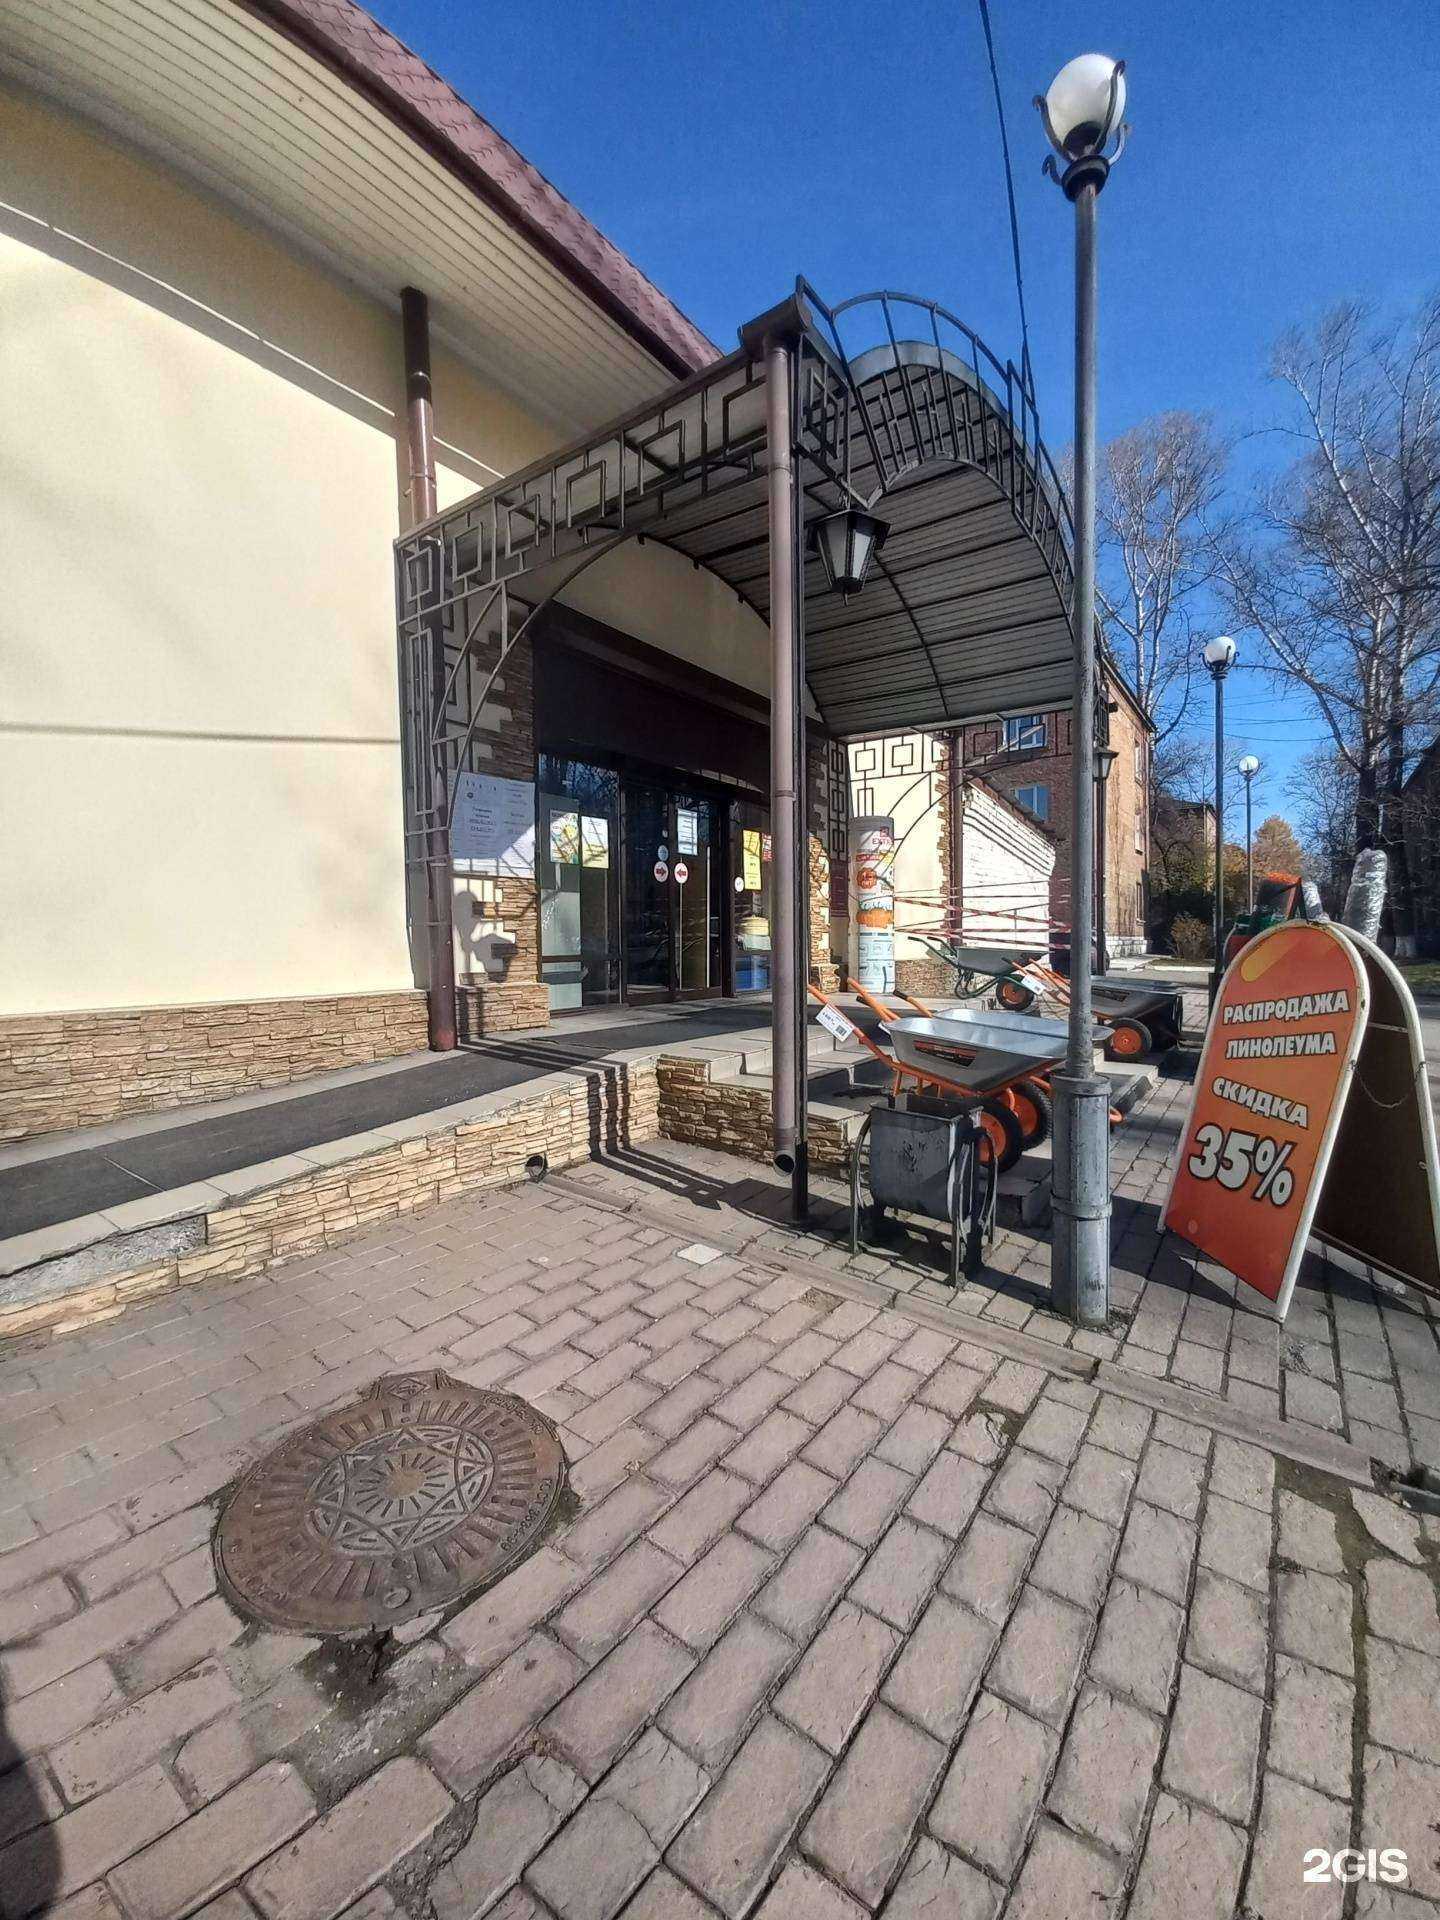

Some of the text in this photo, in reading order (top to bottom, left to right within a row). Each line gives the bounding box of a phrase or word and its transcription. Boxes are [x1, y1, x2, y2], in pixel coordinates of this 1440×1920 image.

[1223, 990, 1350, 1025] РАСПРОДАЖА
[1225, 1032, 1337, 1059] ЛИНОЛЕУМА
[1212, 1076, 1309, 1129] СКИДКА
[1188, 1122, 1297, 1207] 35%
